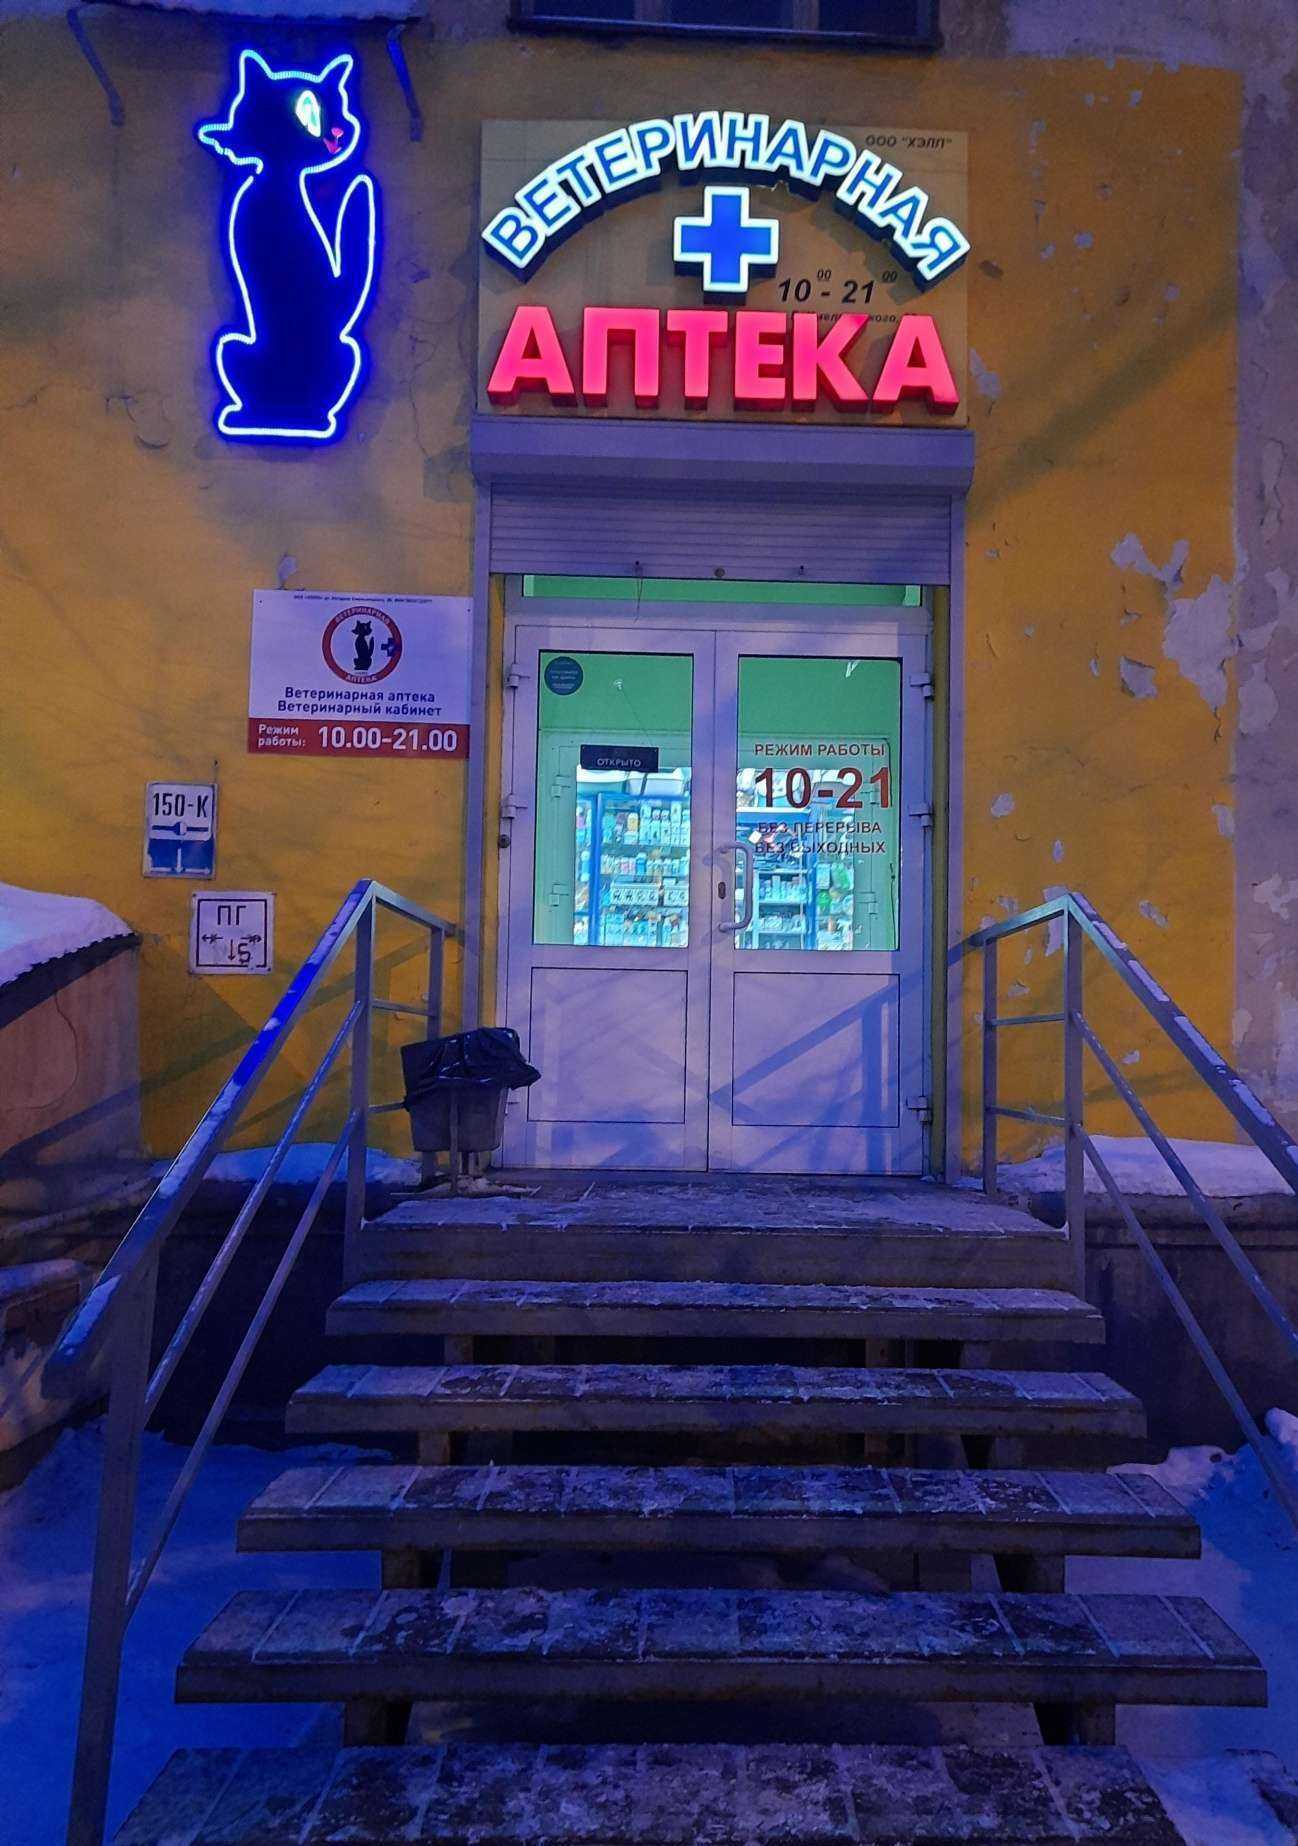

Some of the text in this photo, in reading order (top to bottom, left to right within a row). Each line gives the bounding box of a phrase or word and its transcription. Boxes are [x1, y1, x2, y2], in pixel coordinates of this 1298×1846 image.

[865, 135, 897, 147] ООО
[481, 111, 970, 281] ВЕТЕРИНАРНАЯ
[778, 278, 812, 302] 10
[817, 270, 832, 282] 00
[841, 280, 875, 303] 21
[882, 271, 898, 283] 00
[487, 306, 960, 410] АПТЕКА
[284, 687, 435, 703] Ветеринарная аптека
[277, 700, 442, 716] Ветеринарный кабинет
[258, 724, 299, 736] Режим
[257, 736, 306, 748] работы:
[318, 726, 458, 752] 10.00-21.00
[755, 743, 885, 756] РЕЖИМ РАБОТЫ
[596, 758, 642, 768] ОТКРЫТО
[755, 767, 889, 808] 10-21
[152, 792, 209, 818] 150-К
[794, 822, 882, 834] ПЕРЕРЫВА
[755, 842, 886, 856] БЕЗ ВЫХОДНЫХ
[217, 904, 247, 926] ПГ
